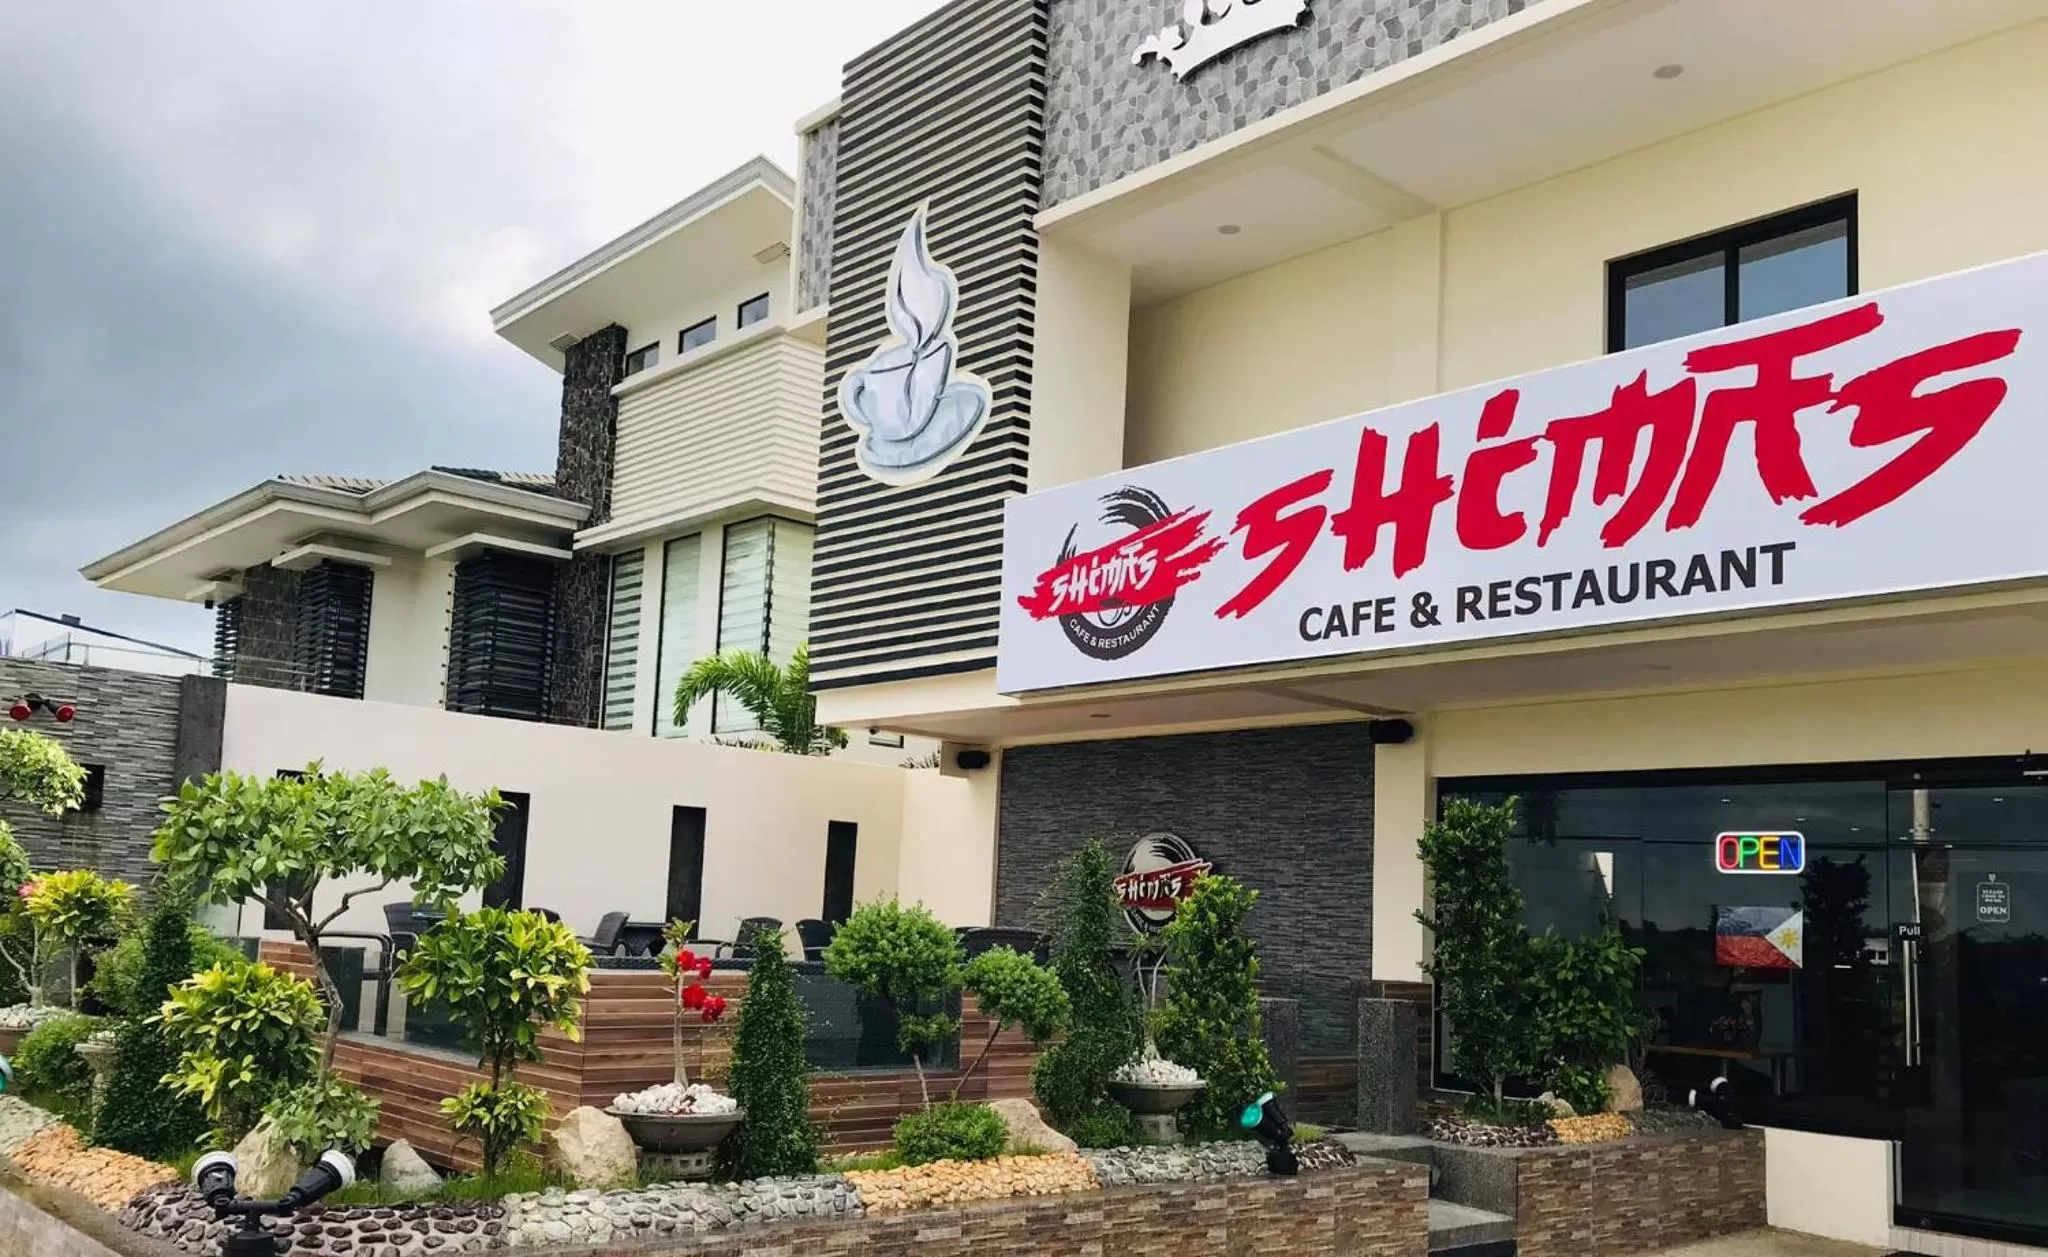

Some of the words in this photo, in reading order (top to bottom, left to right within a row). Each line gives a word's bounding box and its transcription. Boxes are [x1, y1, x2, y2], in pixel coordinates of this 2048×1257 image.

[1299, 596, 1397, 642] CAFE
[1409, 591, 1442, 629] &
[1456, 541, 1796, 623] RESTAURANT
[1069, 618, 1090, 643] CAFE
[1090, 636, 1098, 648] &
[1098, 605, 1160, 649] RESTAURANT
[1719, 836, 1801, 870] OPEN
[1979, 906, 2007, 915] OPEN
[1899, 925, 1921, 936] Pull
